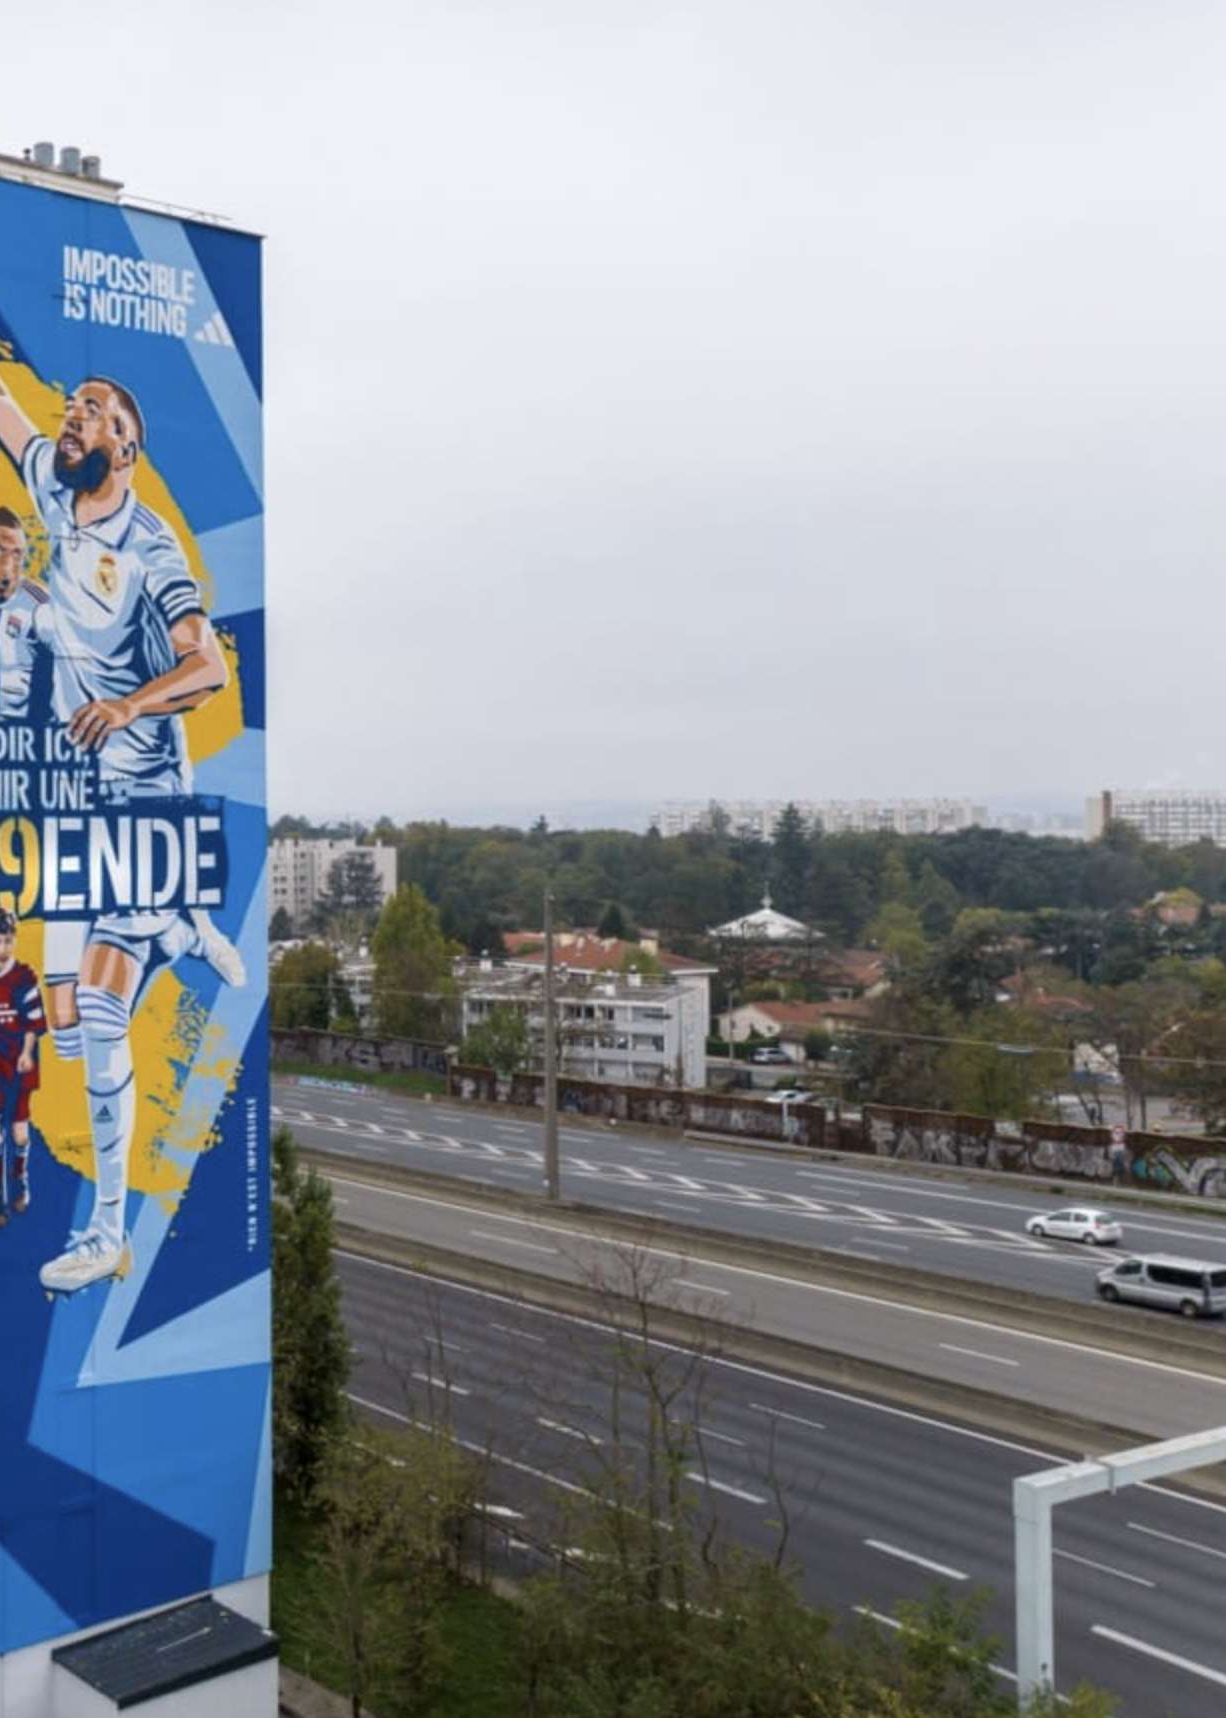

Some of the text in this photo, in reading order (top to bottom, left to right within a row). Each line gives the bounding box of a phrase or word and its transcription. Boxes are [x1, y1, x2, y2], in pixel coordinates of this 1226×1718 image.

[63, 245, 195, 305] IMPOSSIBLE
[63, 281, 187, 339] IS NOTHING
[39, 768, 95, 811] UNE
